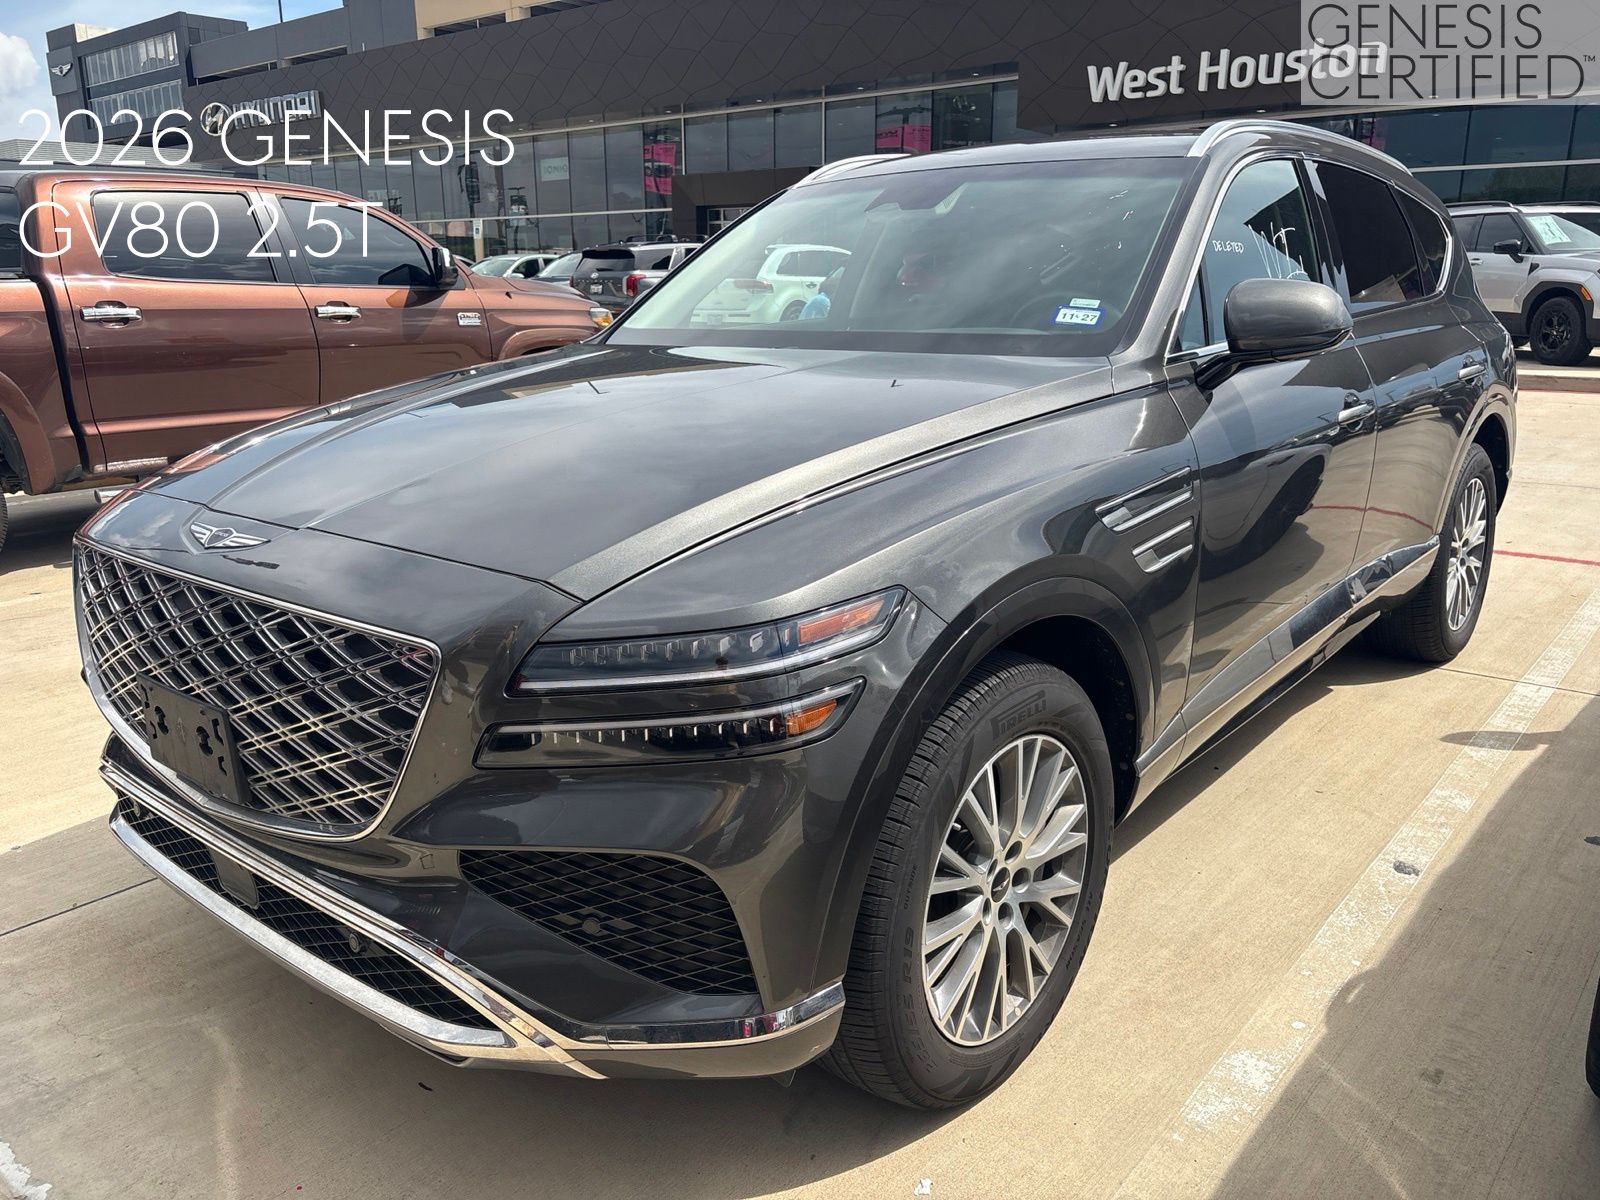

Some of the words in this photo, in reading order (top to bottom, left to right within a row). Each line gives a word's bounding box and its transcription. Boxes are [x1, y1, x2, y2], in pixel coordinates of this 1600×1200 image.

[1087, 54, 1185, 104] West
[1197, 37, 1388, 93] Houston
[1212, 240, 1245, 254] DELETED
[1081, 313, 1098, 322] 27
[990, 689, 1047, 741] PIRELLI
